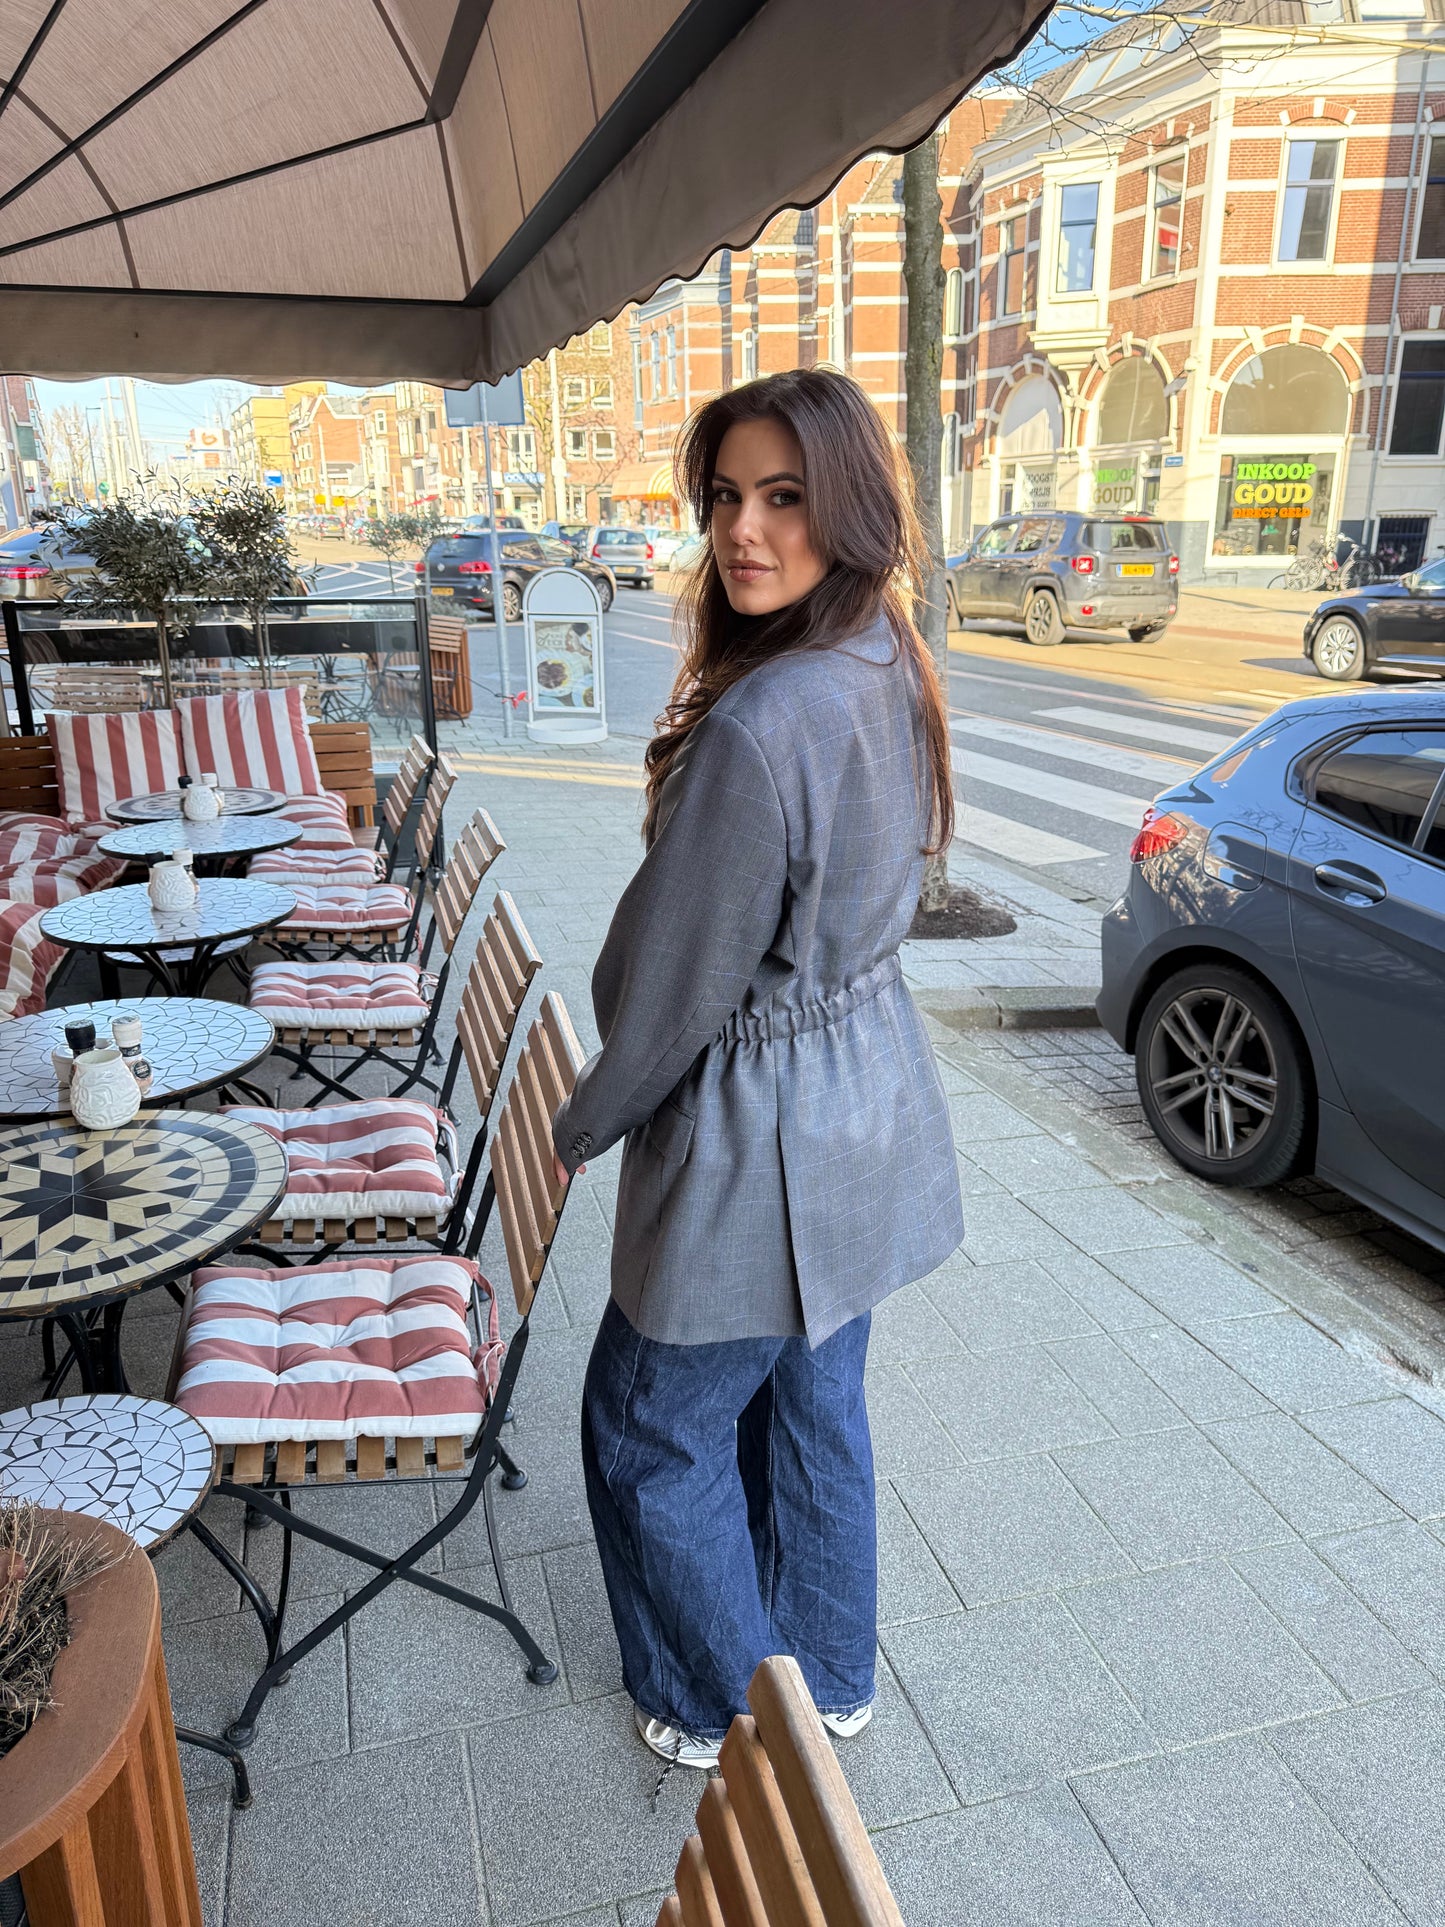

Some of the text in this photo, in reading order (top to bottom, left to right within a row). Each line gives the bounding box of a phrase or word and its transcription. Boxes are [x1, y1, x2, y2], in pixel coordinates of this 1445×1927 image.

[1096, 467, 1136, 483] OOP
[1237, 463, 1316, 480] INKOOP
[1093, 486, 1134, 504] GOUD
[1234, 483, 1314, 505] GOUD
[1232, 507, 1311, 518] DIRECT GELD
